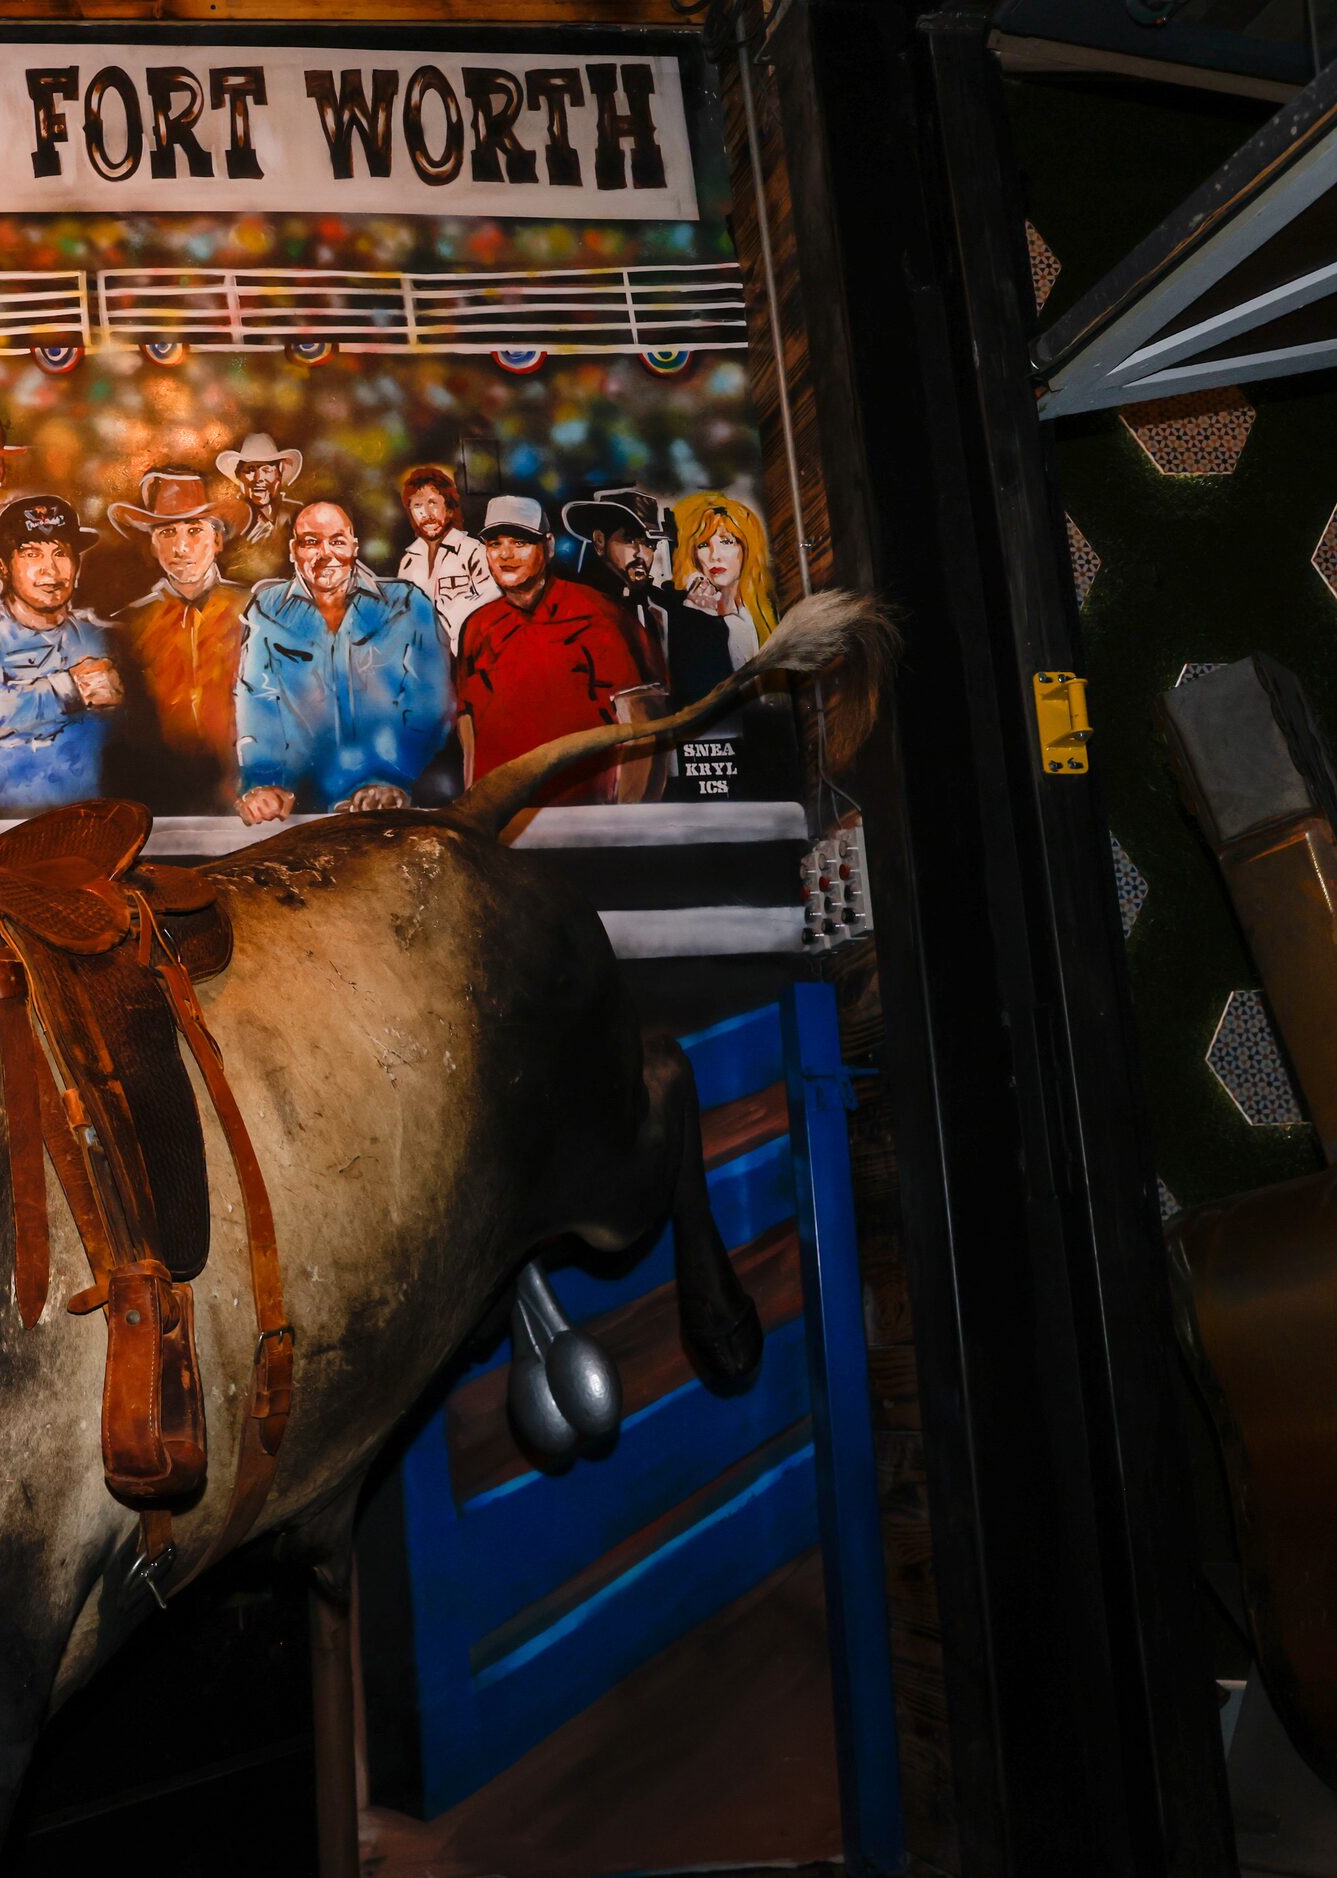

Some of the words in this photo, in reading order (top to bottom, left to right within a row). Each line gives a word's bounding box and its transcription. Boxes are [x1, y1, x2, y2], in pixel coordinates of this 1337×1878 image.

[25, 64, 269, 183] FORT
[304, 63, 668, 191] WORTH
[683, 742, 736, 758] SNEA
[685, 762, 738, 777] KRYL
[699, 780, 730, 795] ICS
